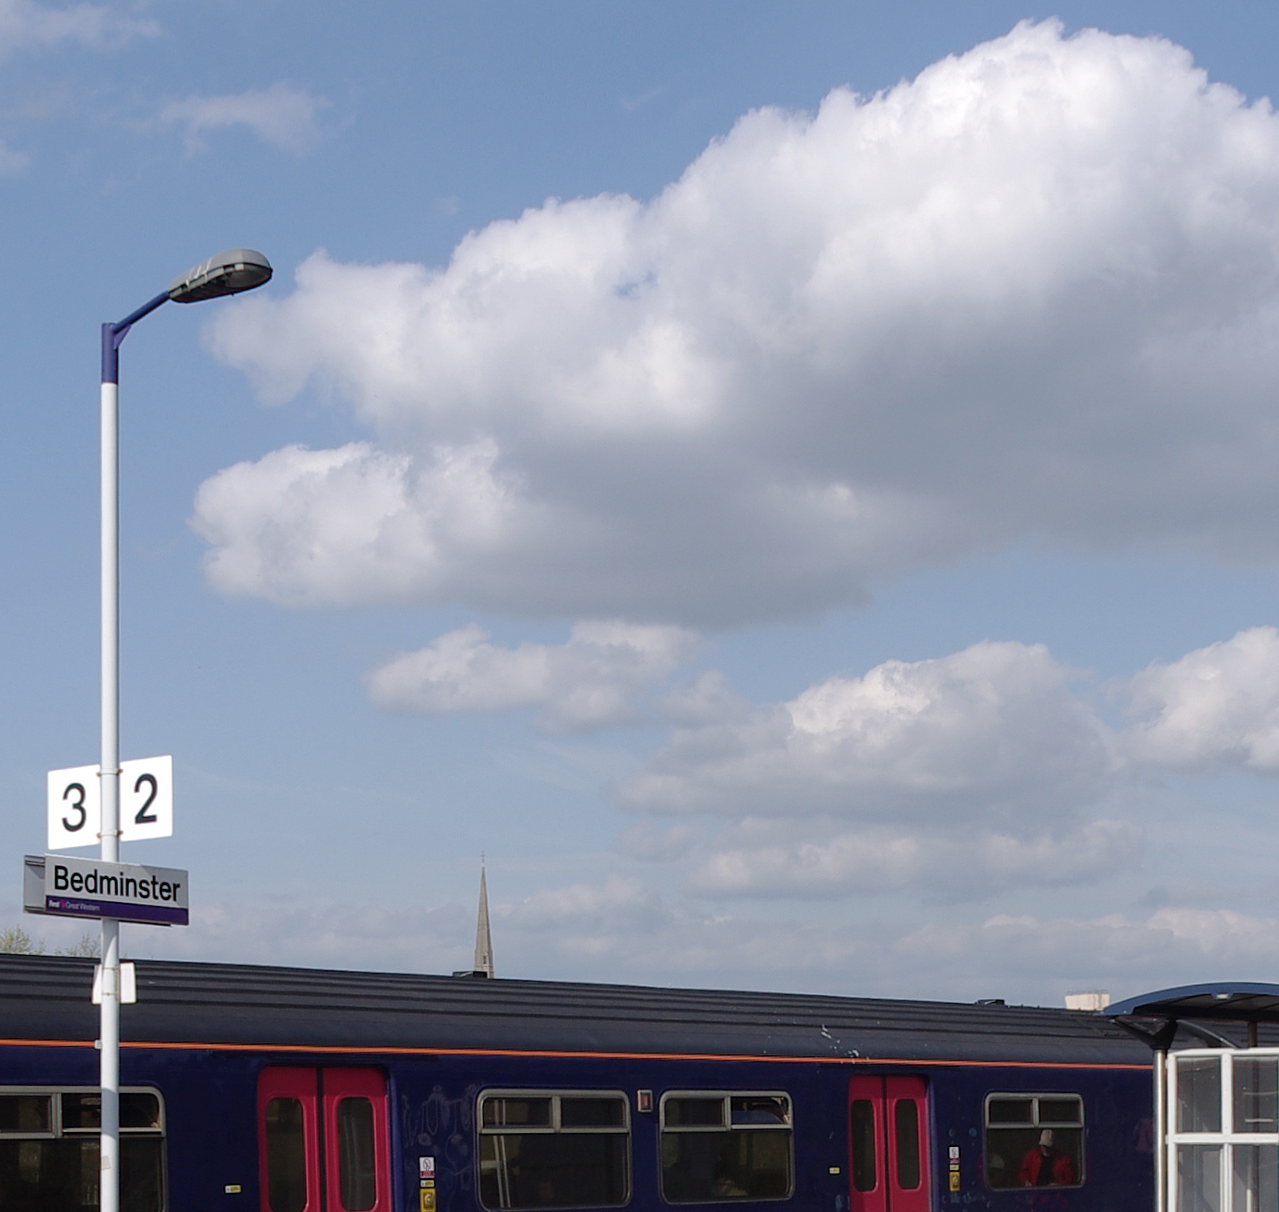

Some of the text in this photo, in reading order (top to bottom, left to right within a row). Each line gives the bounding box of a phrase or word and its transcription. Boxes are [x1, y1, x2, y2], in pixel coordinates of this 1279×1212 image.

[62, 783, 86, 832] 3
[134, 773, 158, 824] 2
[54, 865, 180, 902] Bedminster
